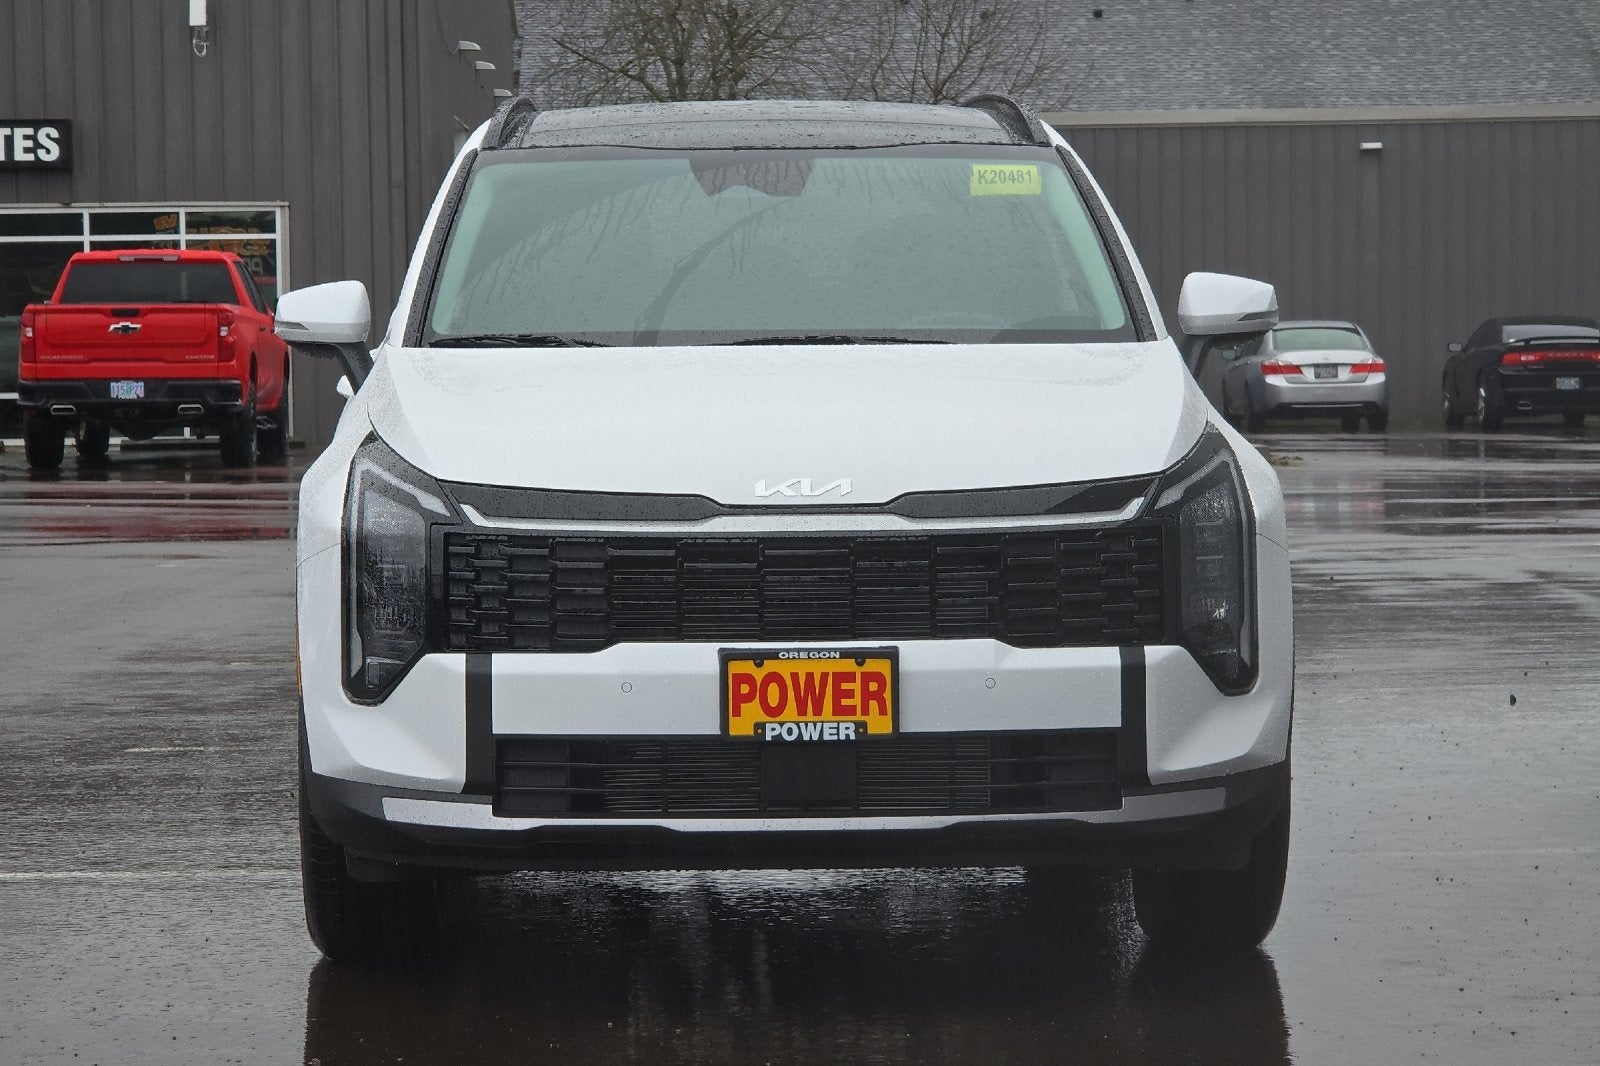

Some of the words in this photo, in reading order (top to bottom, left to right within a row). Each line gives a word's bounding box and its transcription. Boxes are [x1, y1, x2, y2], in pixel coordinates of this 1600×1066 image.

[977, 169, 1032, 185] K20481
[778, 651, 840, 659] OREGON
[731, 671, 888, 718] POWER
[765, 722, 856, 741] POWER
